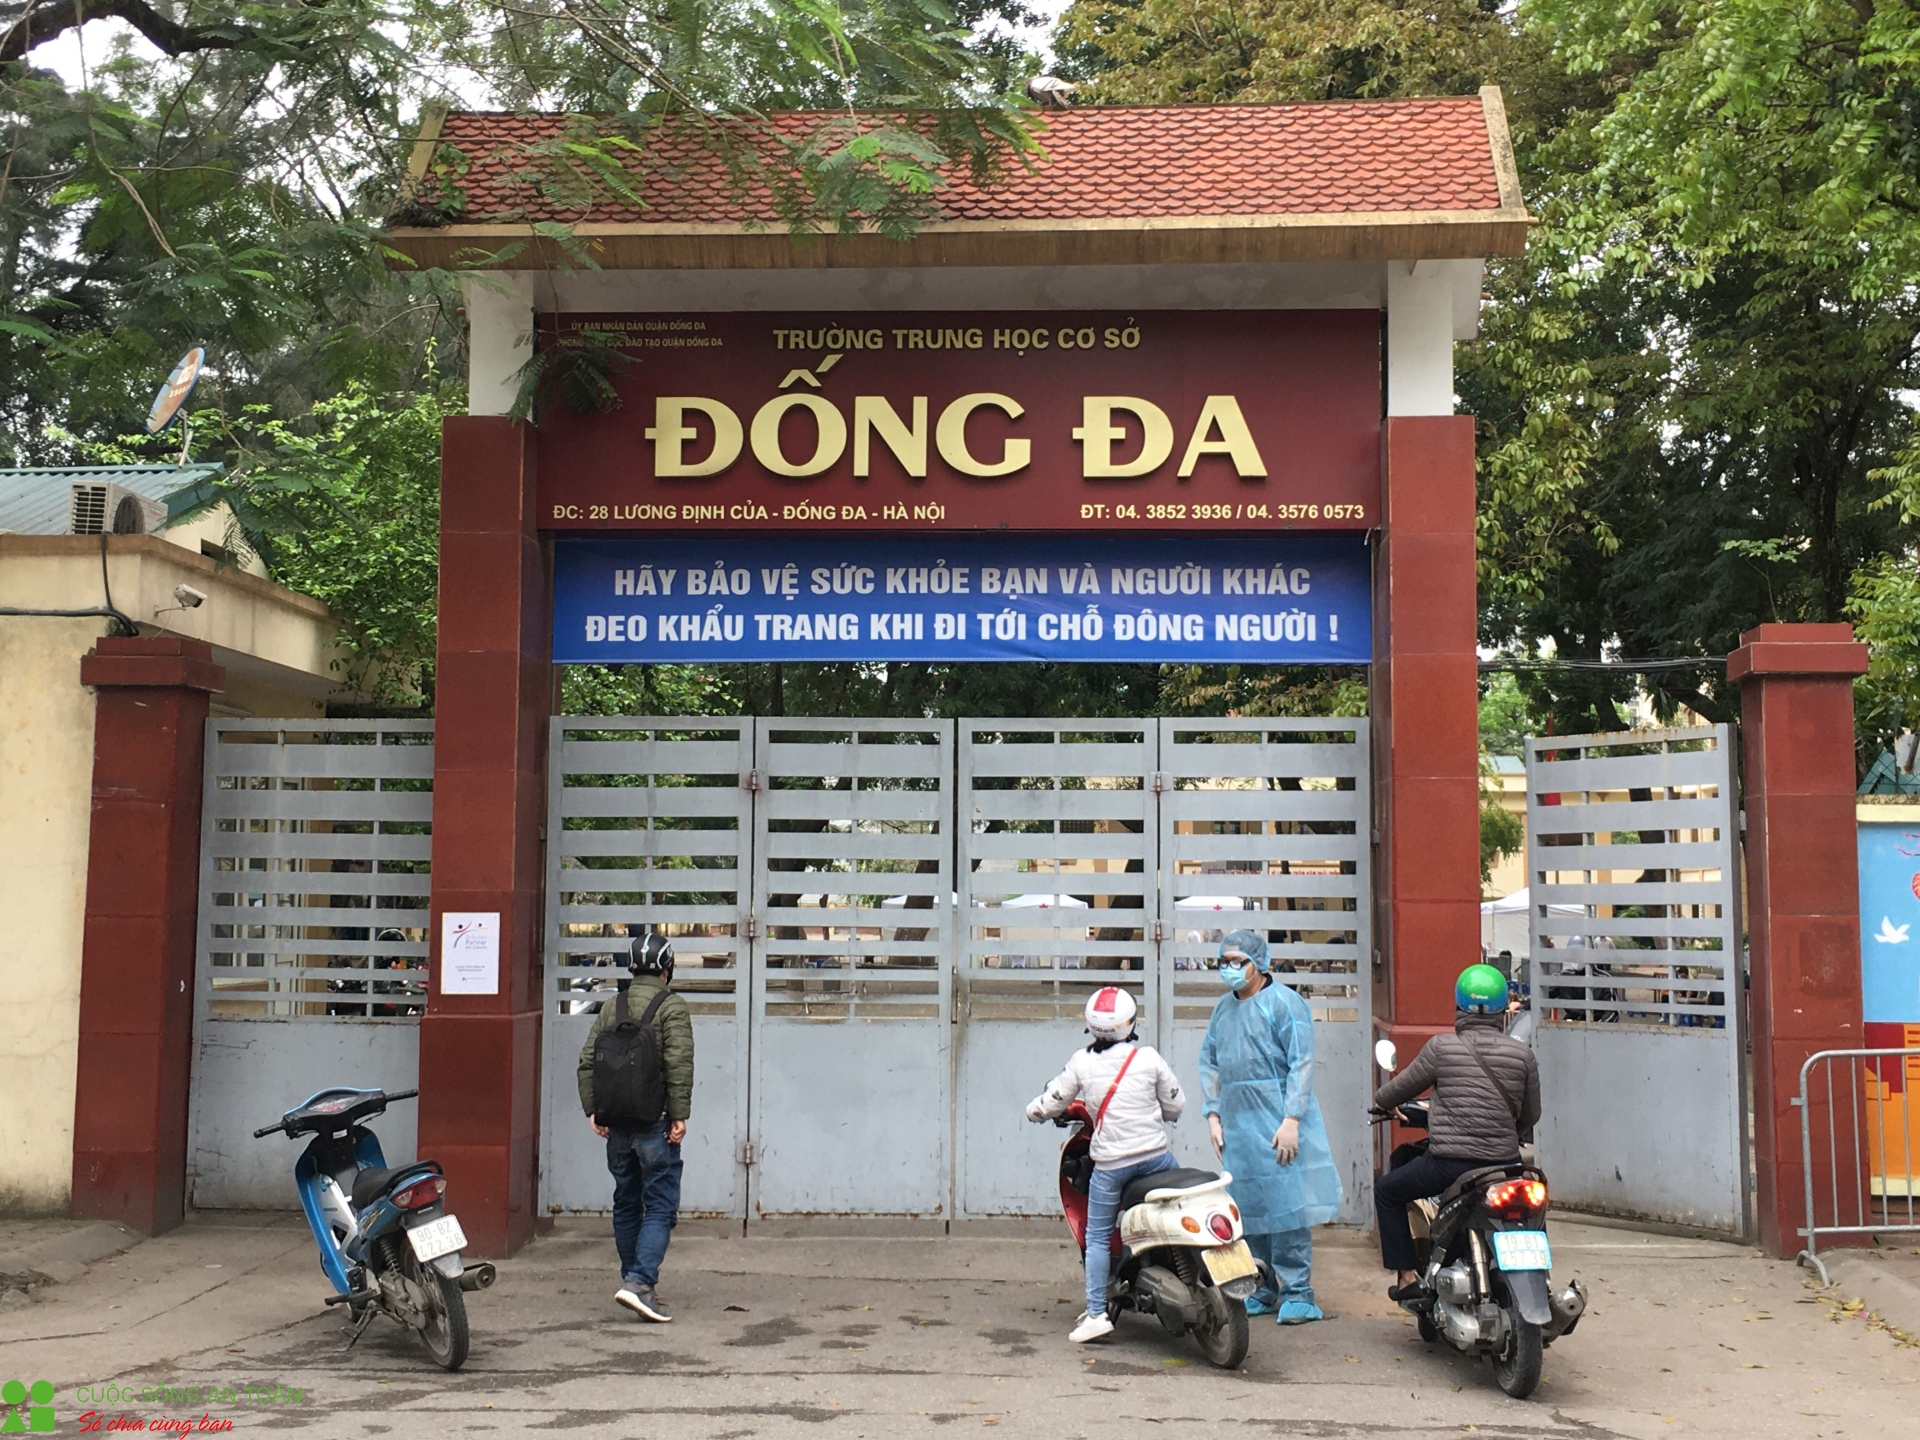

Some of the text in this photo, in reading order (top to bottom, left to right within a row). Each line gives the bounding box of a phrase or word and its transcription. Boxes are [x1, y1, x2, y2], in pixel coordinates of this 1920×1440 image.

[773, 317, 1141, 356] TRƯỜNG TRUNG HỌC CƠ SỞ
[644, 353, 1268, 480] ĐỐNG ĐA
[552, 505, 584, 520] ĐC:
[589, 505, 609, 520] 28
[614, 504, 677, 520] LƯƠNG
[681, 505, 725, 524] ĐỊNH
[730, 500, 768, 520] CỦA
[783, 498, 836, 520] ĐỐNG
[841, 504, 868, 520] ĐA
[883, 500, 908, 520] HÀ
[914, 501, 945, 524] NỘI
[1080, 504, 1364, 519] ĐT: 04. 3852 3936 / 04. 3576 0573
[614, 558, 1311, 601] HÃY BẢO VỆ SỨC KHỎE BẠN VÀ NGƯỜI KHÁC
[585, 603, 1339, 642] ĐEO KHẨU TRANG KHI ĐI TỚI CHỖ ĐÔNG NGƯỜI !
[416, 1220, 452, 1242] 90-B2
